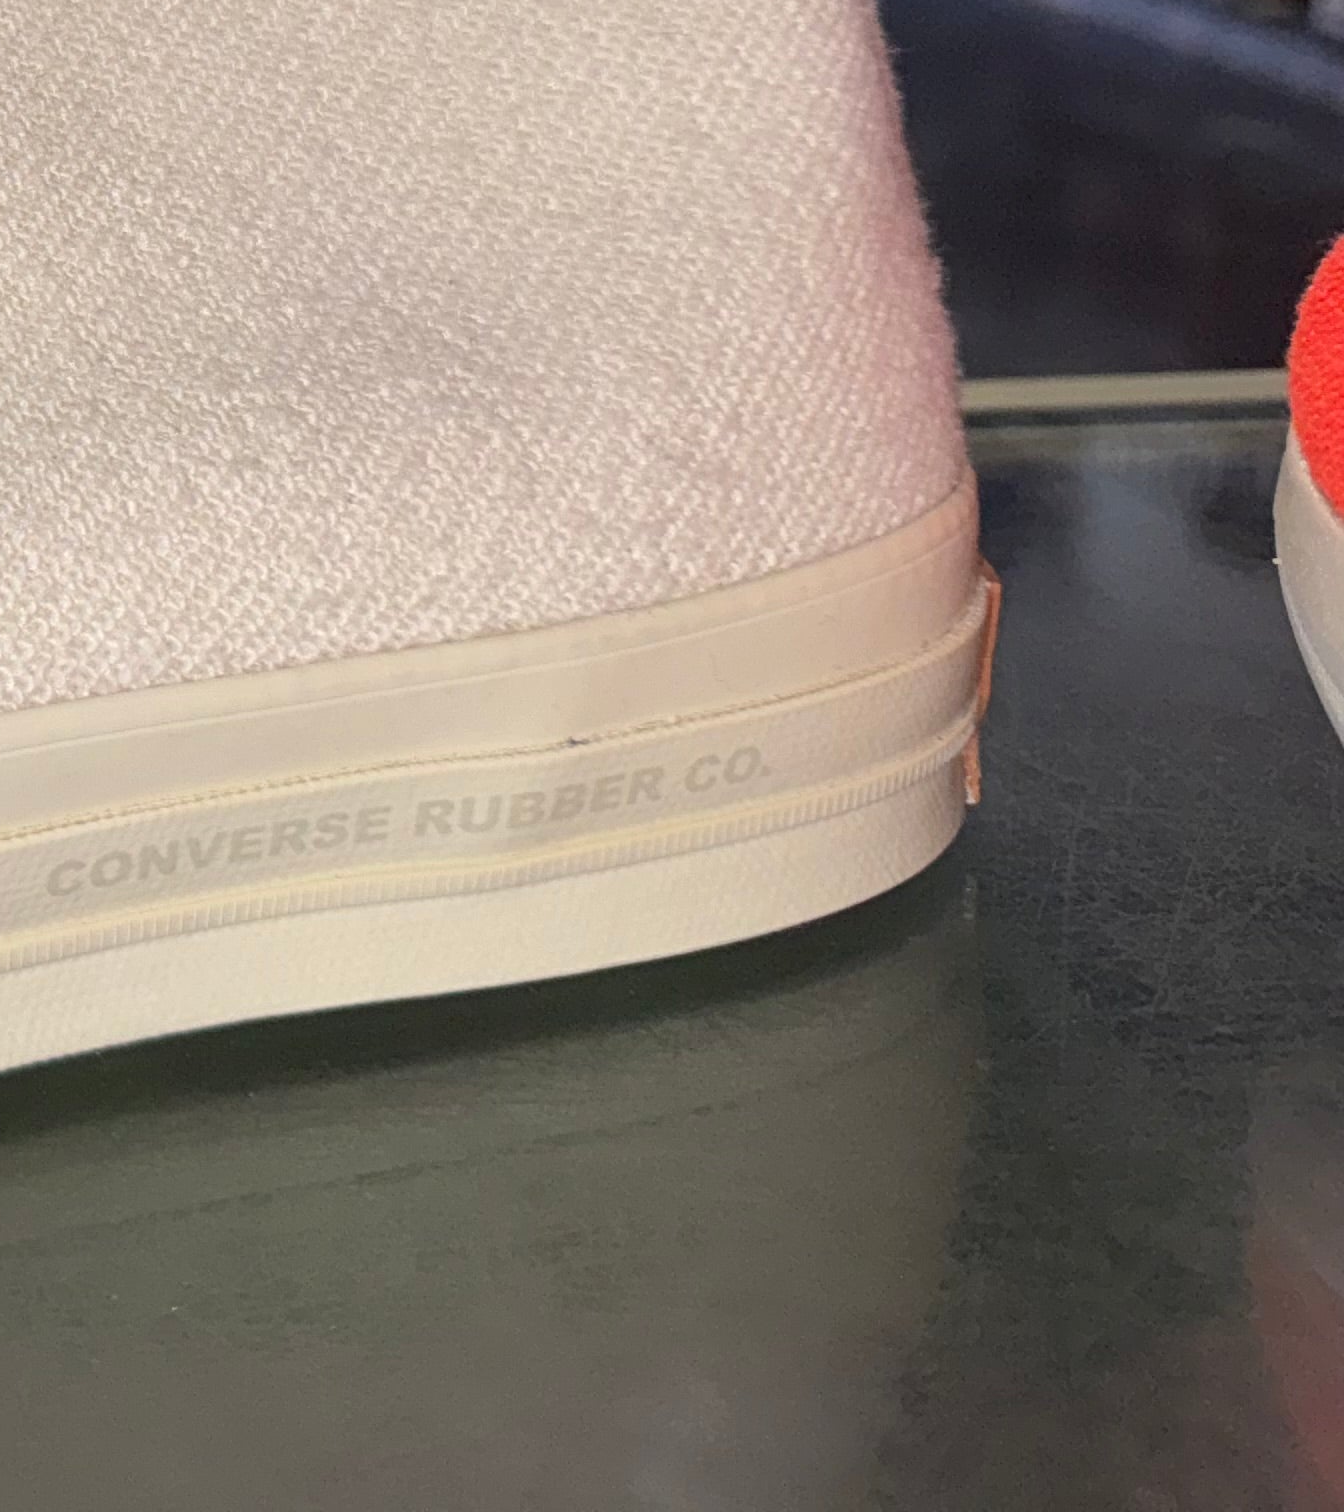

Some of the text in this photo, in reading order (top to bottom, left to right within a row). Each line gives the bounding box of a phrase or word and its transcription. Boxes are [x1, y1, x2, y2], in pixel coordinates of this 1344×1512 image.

[45, 744, 774, 897] CONVERSE RUBBER CO.
